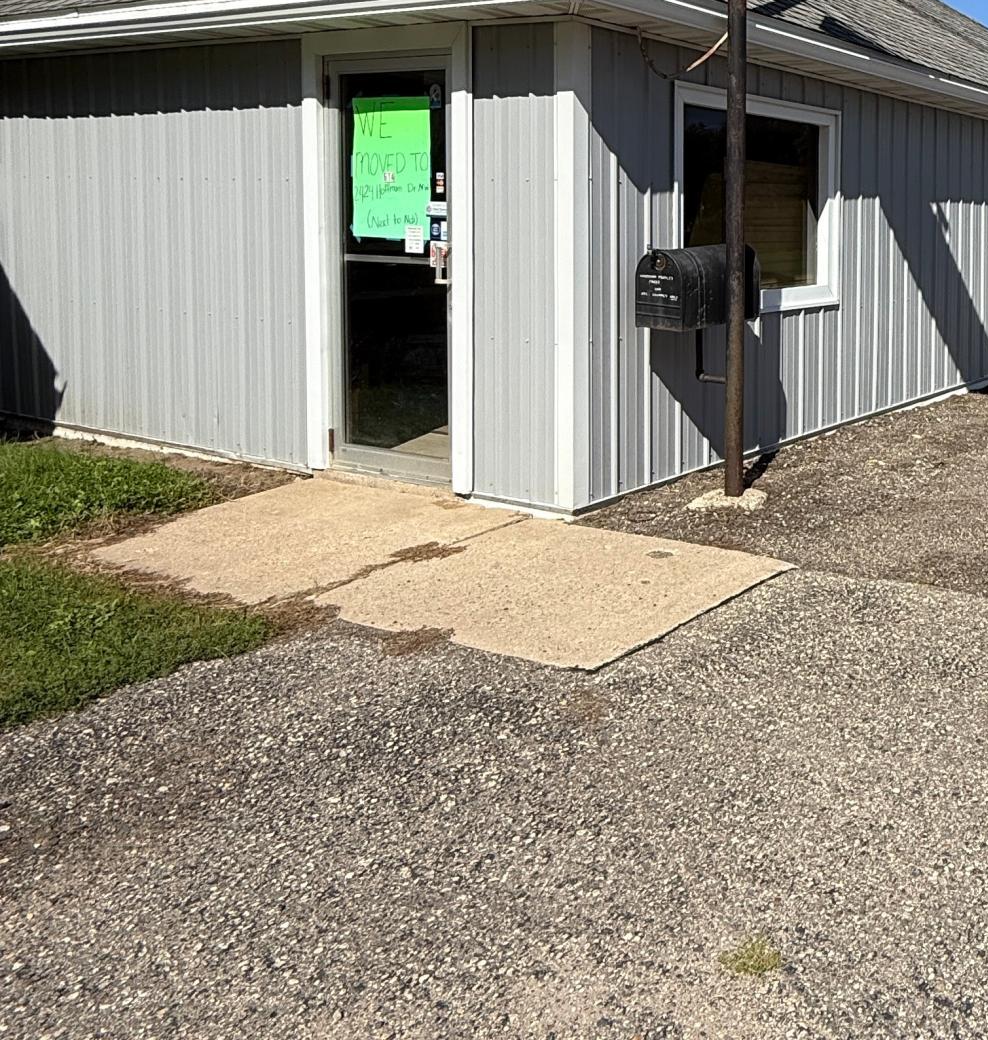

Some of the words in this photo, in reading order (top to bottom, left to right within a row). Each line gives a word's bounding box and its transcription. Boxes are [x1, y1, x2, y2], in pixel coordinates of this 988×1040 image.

[355, 101, 395, 138] WE
[356, 152, 406, 176] MOVED
[410, 152, 428, 172] TO
